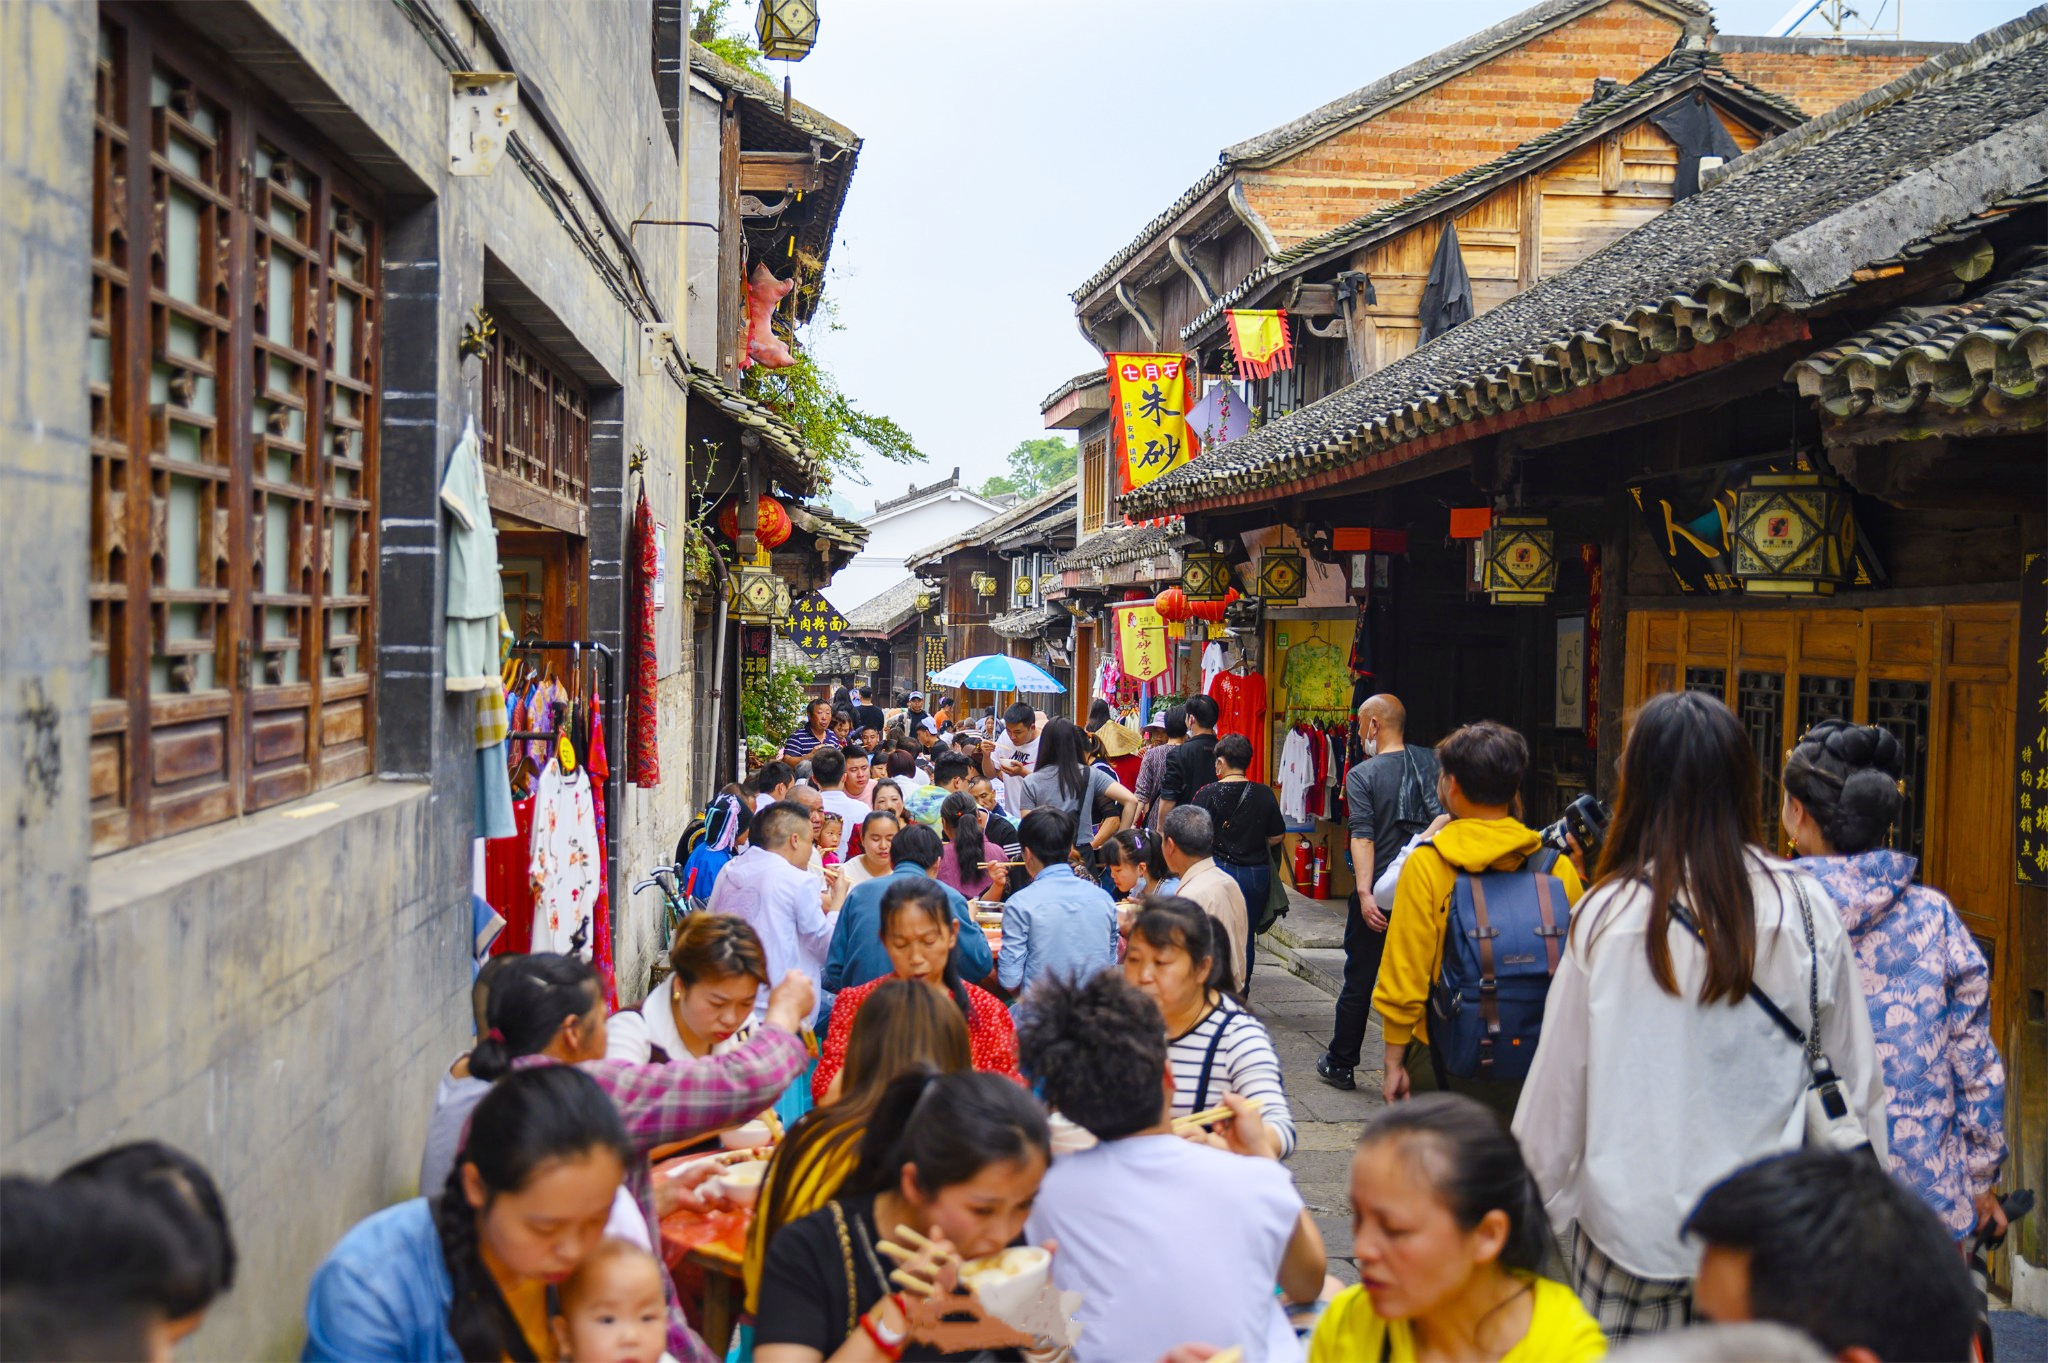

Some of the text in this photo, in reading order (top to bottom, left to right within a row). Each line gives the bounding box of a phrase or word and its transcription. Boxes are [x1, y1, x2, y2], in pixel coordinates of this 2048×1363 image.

[1122, 363, 1179, 380] 七月石
[1137, 383, 1181, 475] 朱砂
[799, 599, 829, 613] 花溪
[785, 614, 843, 633] 牛肉粉面
[800, 635, 828, 649] 老店
[1136, 628, 1152, 677] 朱砂·原石
[1010, 750, 1030, 762] NIKE
[2020, 745, 2033, 857] 特约经销点
